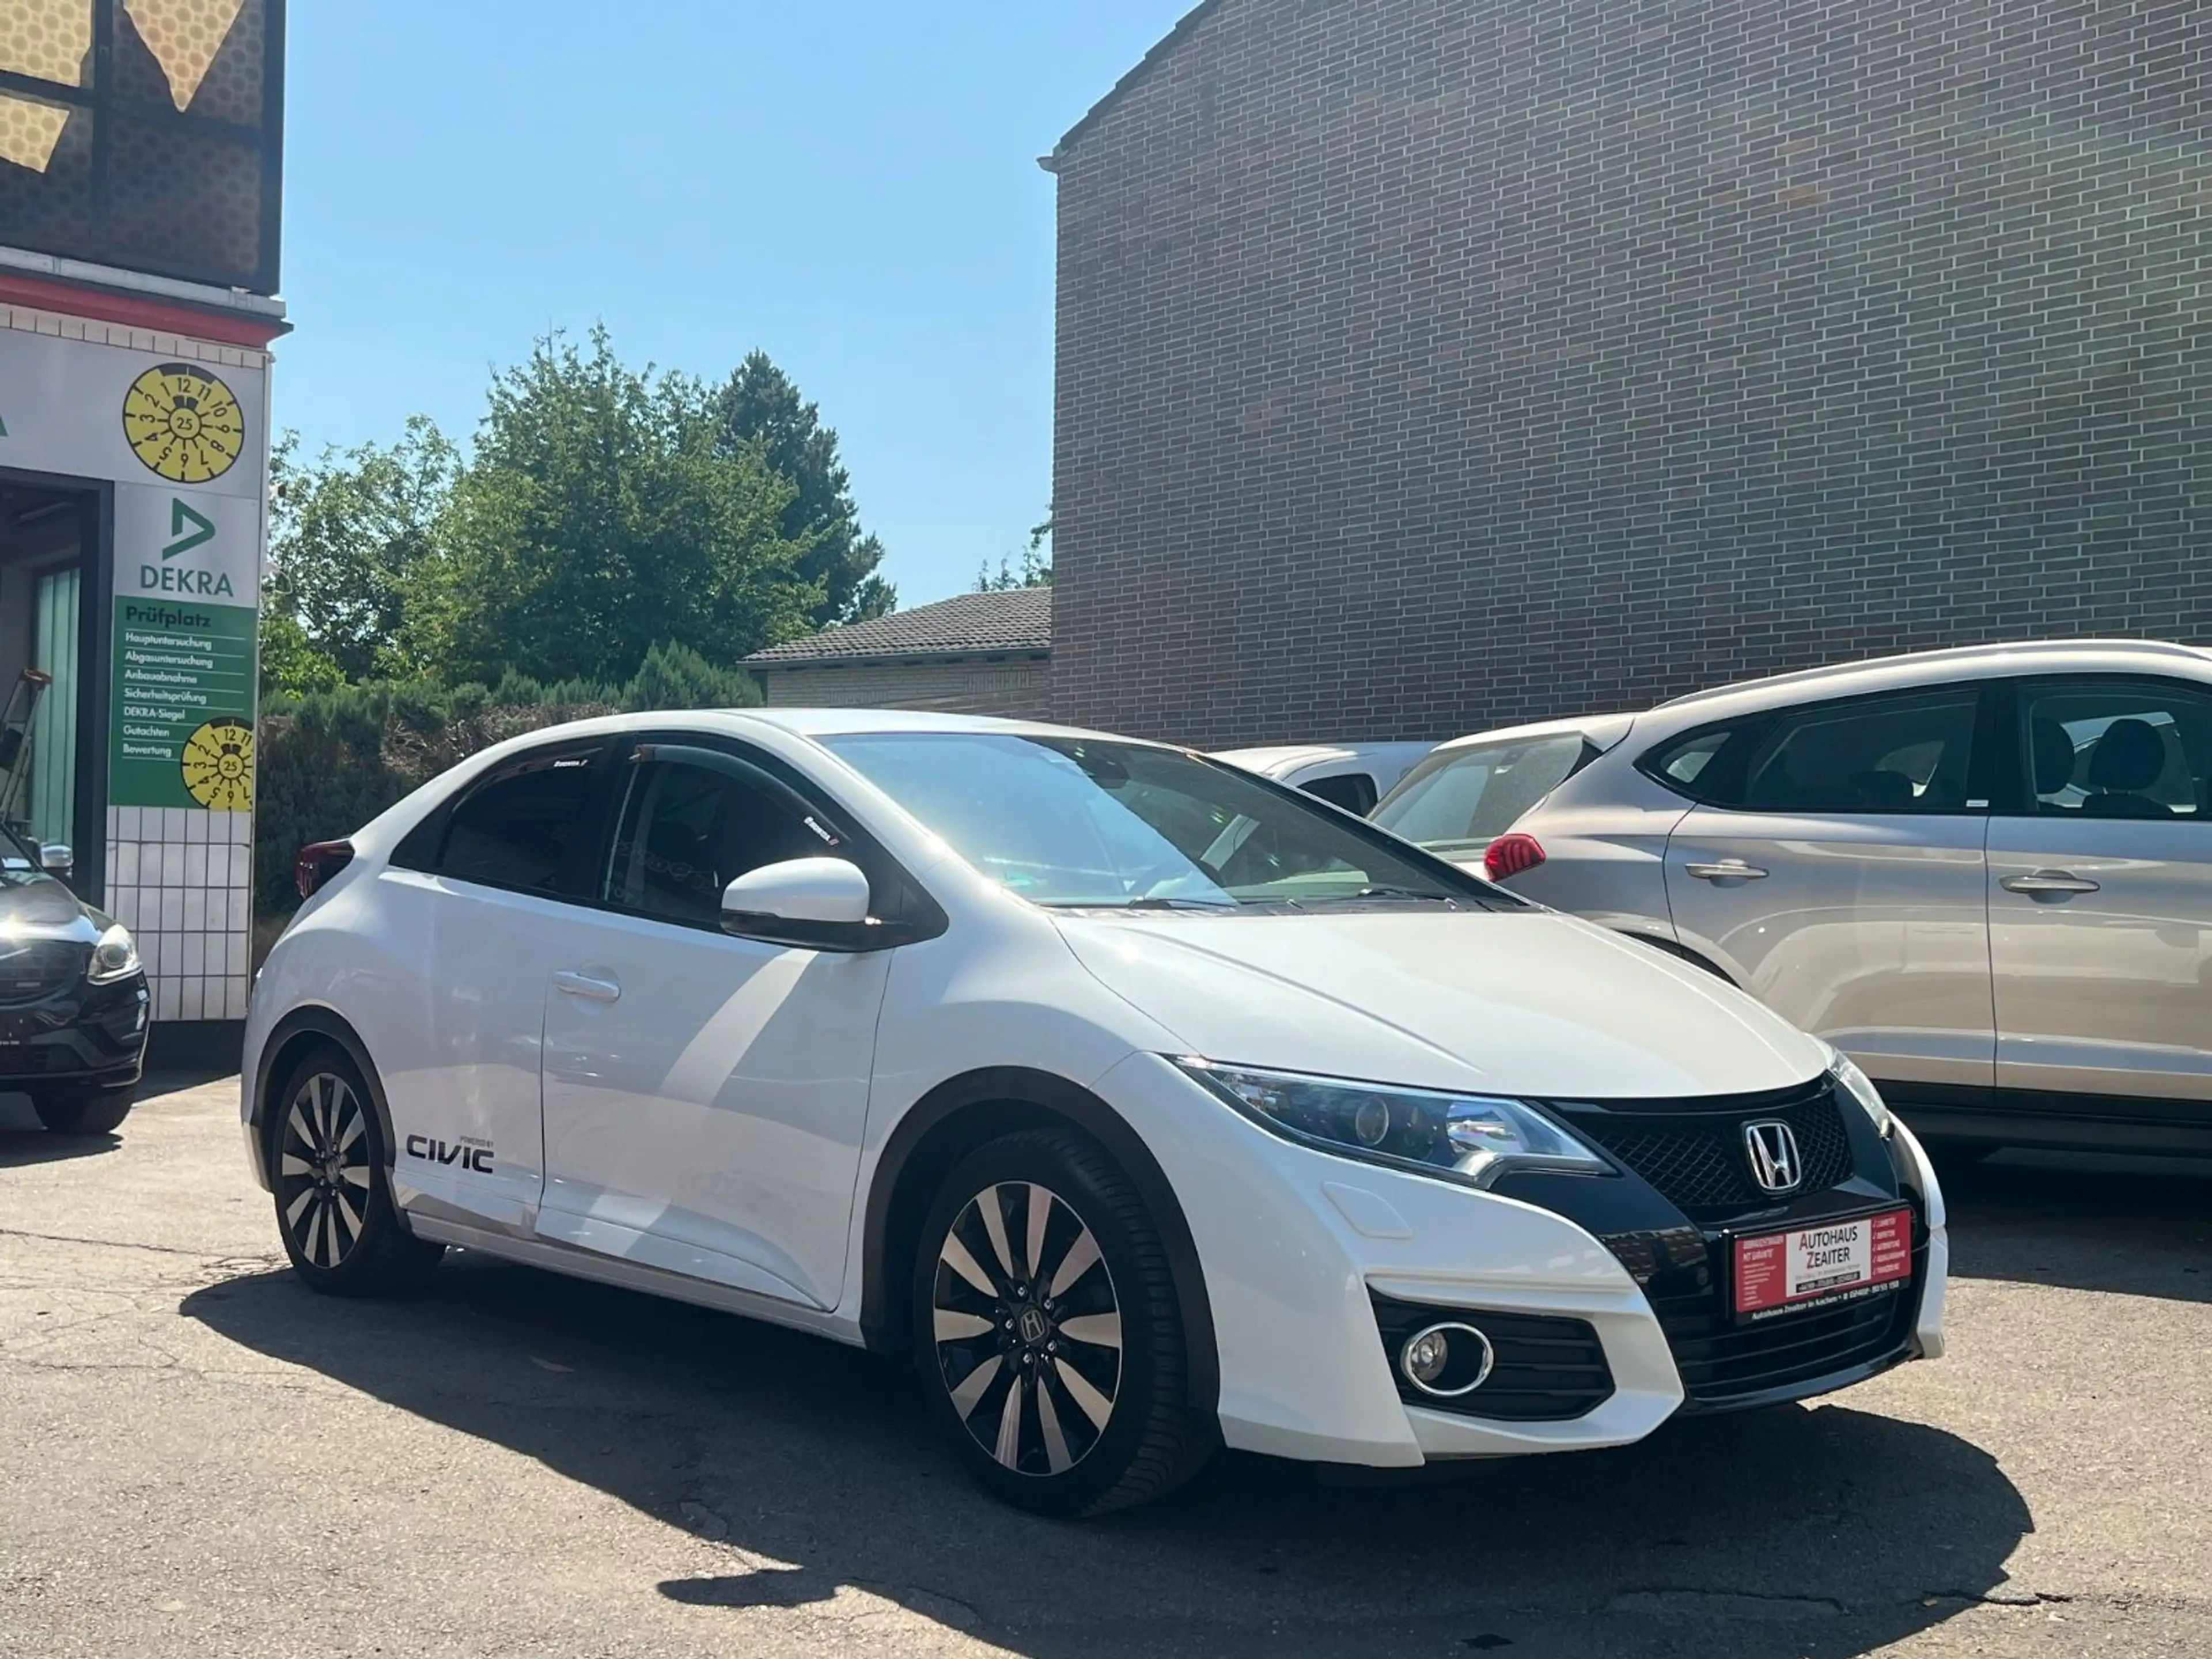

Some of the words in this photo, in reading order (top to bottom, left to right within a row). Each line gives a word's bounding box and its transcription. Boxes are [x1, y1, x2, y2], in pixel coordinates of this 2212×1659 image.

[161, 382, 170, 396] 1
[177, 377, 191, 393] 12
[198, 384, 211, 401] 11
[145, 393, 160, 408] 2
[210, 401, 227, 417] 10
[139, 415, 155, 423] 3
[177, 417, 192, 430] 25
[215, 425, 230, 433] 9
[145, 433, 158, 441] 4
[159, 446, 172, 460] 5
[210, 440, 225, 452] 8
[181, 454, 188, 467] 6
[200, 450, 209, 465] 7
[141, 565, 233, 597] DEKRA
[126, 605, 211, 628] Prüfplatz
[126, 632, 212, 651] Hauptuntersuchung
[125, 650, 213, 669] Abgasuntersuchung
[124, 669, 197, 684] Anbauabnahme
[124, 688, 207, 704] Sicherheitsprüfung
[124, 706, 185, 721] DEKRA-Siegel
[123, 725, 169, 737] Gutachten
[224, 728, 236, 741] 12
[211, 734, 219, 746] 1
[241, 732, 252, 747] 11
[123, 743, 172, 757] Bewertung
[198, 744, 211, 756] 2
[224, 760, 237, 772] 25
[198, 776, 210, 785] 4
[210, 787, 221, 798] 5
[228, 790, 234, 802] 6
[243, 786, 251, 800] 7
[407, 1134, 494, 1174] CIVIC
[1799, 1226, 1858, 1251] AUTOHAUS
[1806, 1247, 1850, 1269] ZEAITER
